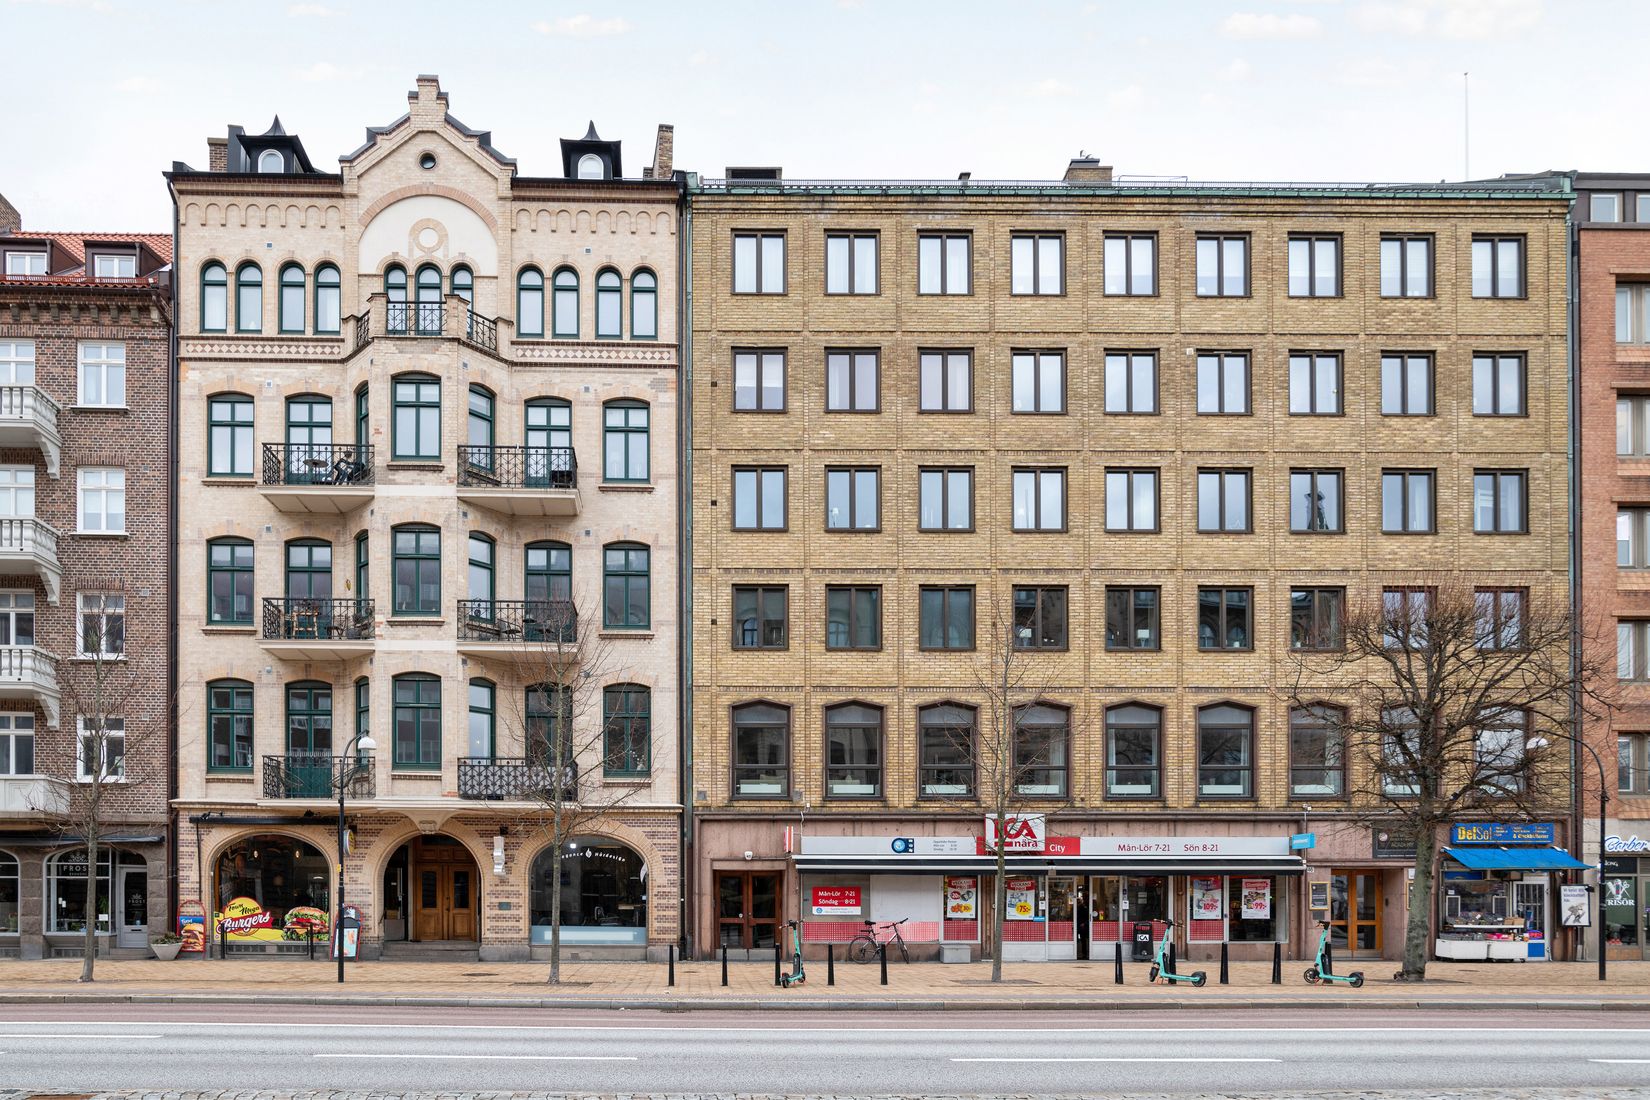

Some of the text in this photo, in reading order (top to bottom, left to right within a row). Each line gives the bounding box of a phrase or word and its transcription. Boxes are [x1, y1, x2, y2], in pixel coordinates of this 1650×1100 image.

[994, 817, 1037, 839] ICA
[1014, 839, 1038, 847] nära
[1154, 843, 1171, 852] 7-21
[1183, 843, 1219, 852] Sön 8-21
[1049, 844, 1065, 854] City
[1606, 898, 1635, 906] RISÖR
[217, 912, 270, 933] Burgers
